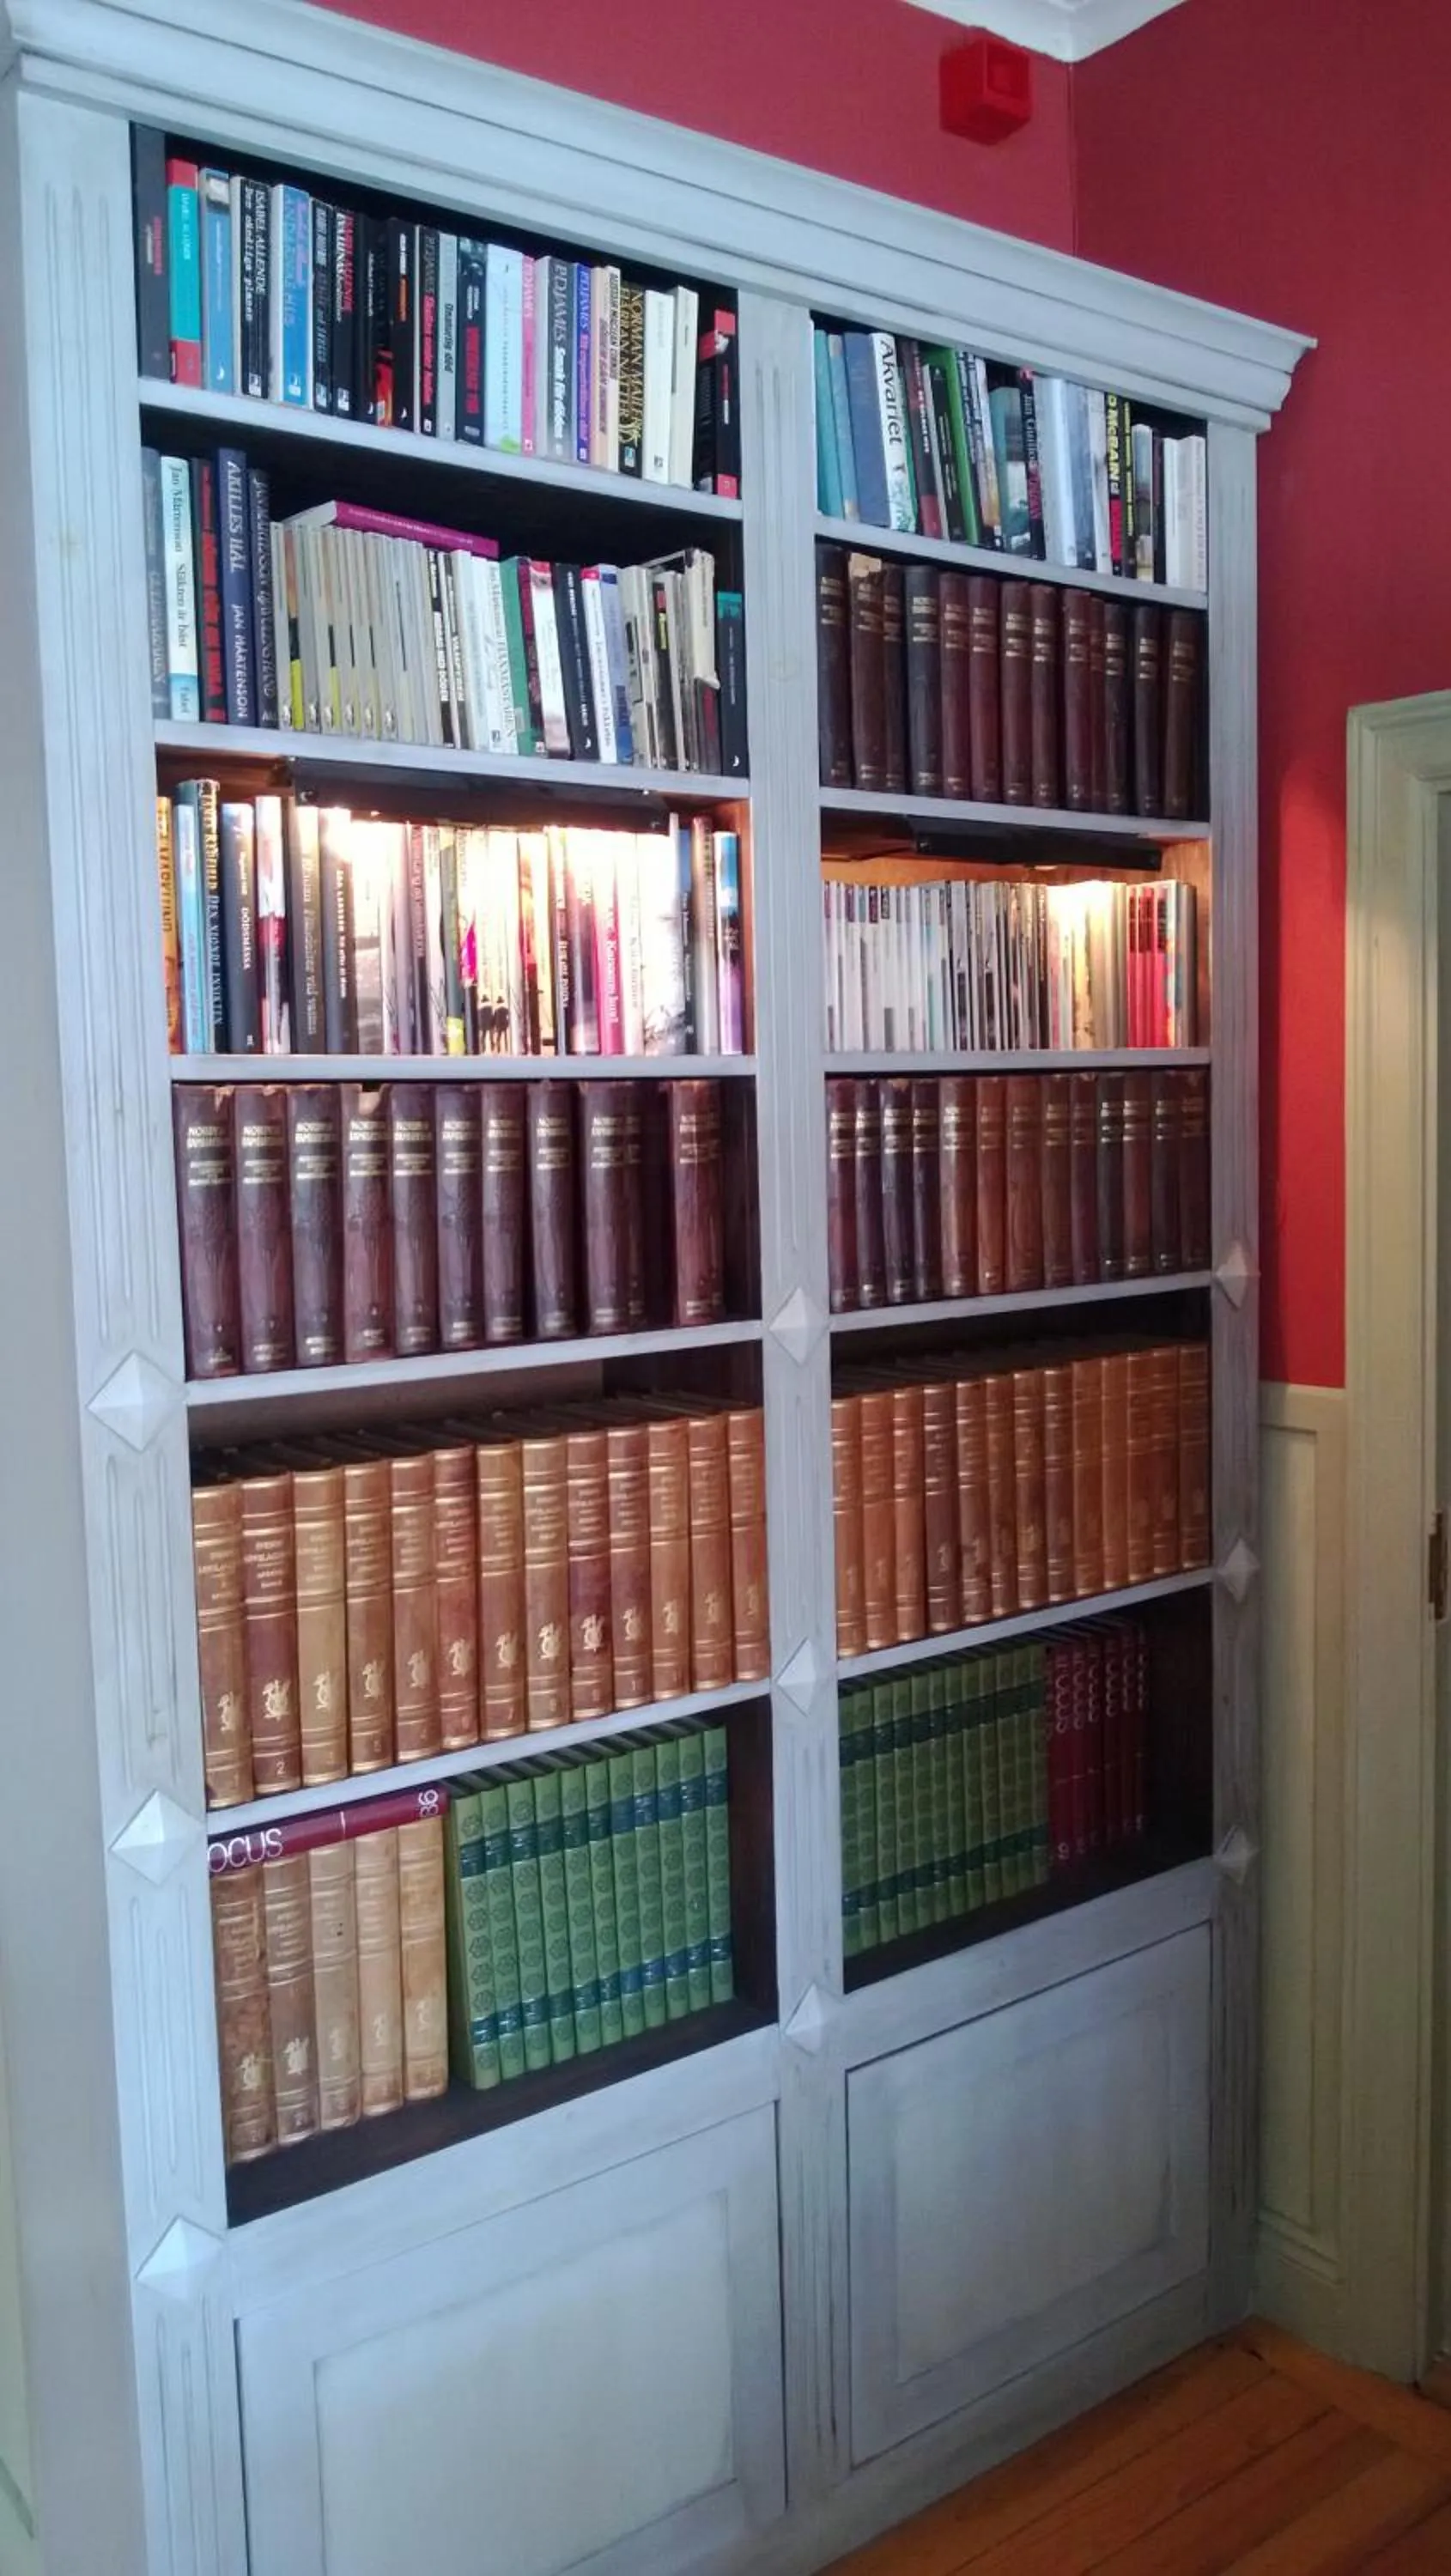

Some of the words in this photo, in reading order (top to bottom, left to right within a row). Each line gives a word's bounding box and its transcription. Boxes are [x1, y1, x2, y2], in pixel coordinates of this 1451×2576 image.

[245, 186, 254, 209] Den
[255, 190, 266, 234] ISABEL
[256, 235, 266, 295] ALLENDE
[244, 278, 254, 322] planen
[631, 289, 643, 366] NORMAN
[444, 352, 454, 374] död
[880, 340, 902, 445] Akvariet
[1023, 395, 1034, 416] Jan
[169, 466, 183, 485] Jan
[227, 461, 245, 534] AKILLES
[172, 490, 185, 553] Mårtenson
[230, 538, 247, 573] HÄL
[174, 563, 186, 608] Släkten
[231, 604, 246, 630] JAN
[234, 635, 248, 718] MÅRTENSON
[240, 907, 252, 969] DÖDSMÄSSA
[306, 975, 319, 995] vid
[275, 1760, 285, 1775] 2
